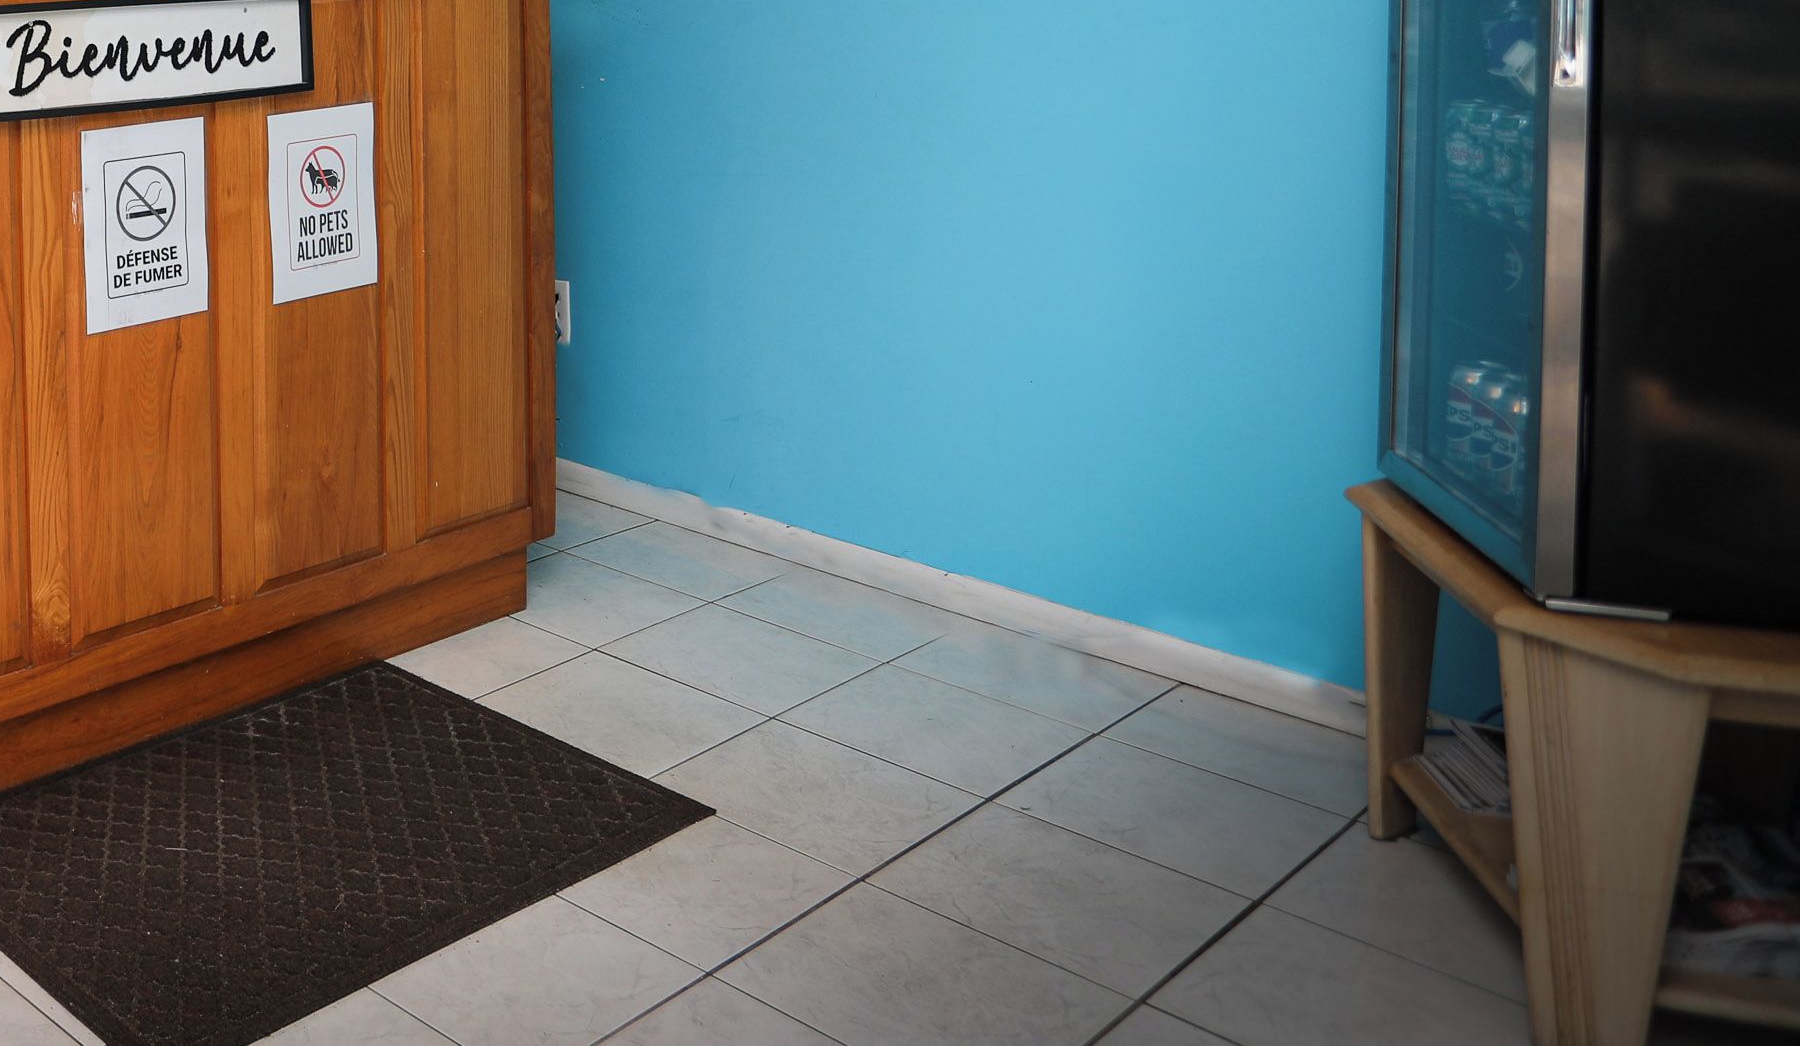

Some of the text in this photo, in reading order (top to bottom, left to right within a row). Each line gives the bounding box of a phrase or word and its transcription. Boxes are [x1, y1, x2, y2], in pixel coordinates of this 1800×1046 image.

[6, 19, 277, 97] Bienvenue
[299, 209, 349, 238] NO PETS
[116, 245, 178, 270] DÉFENSE
[296, 231, 354, 263] ALLOWED
[113, 263, 183, 289] DE FUMER
